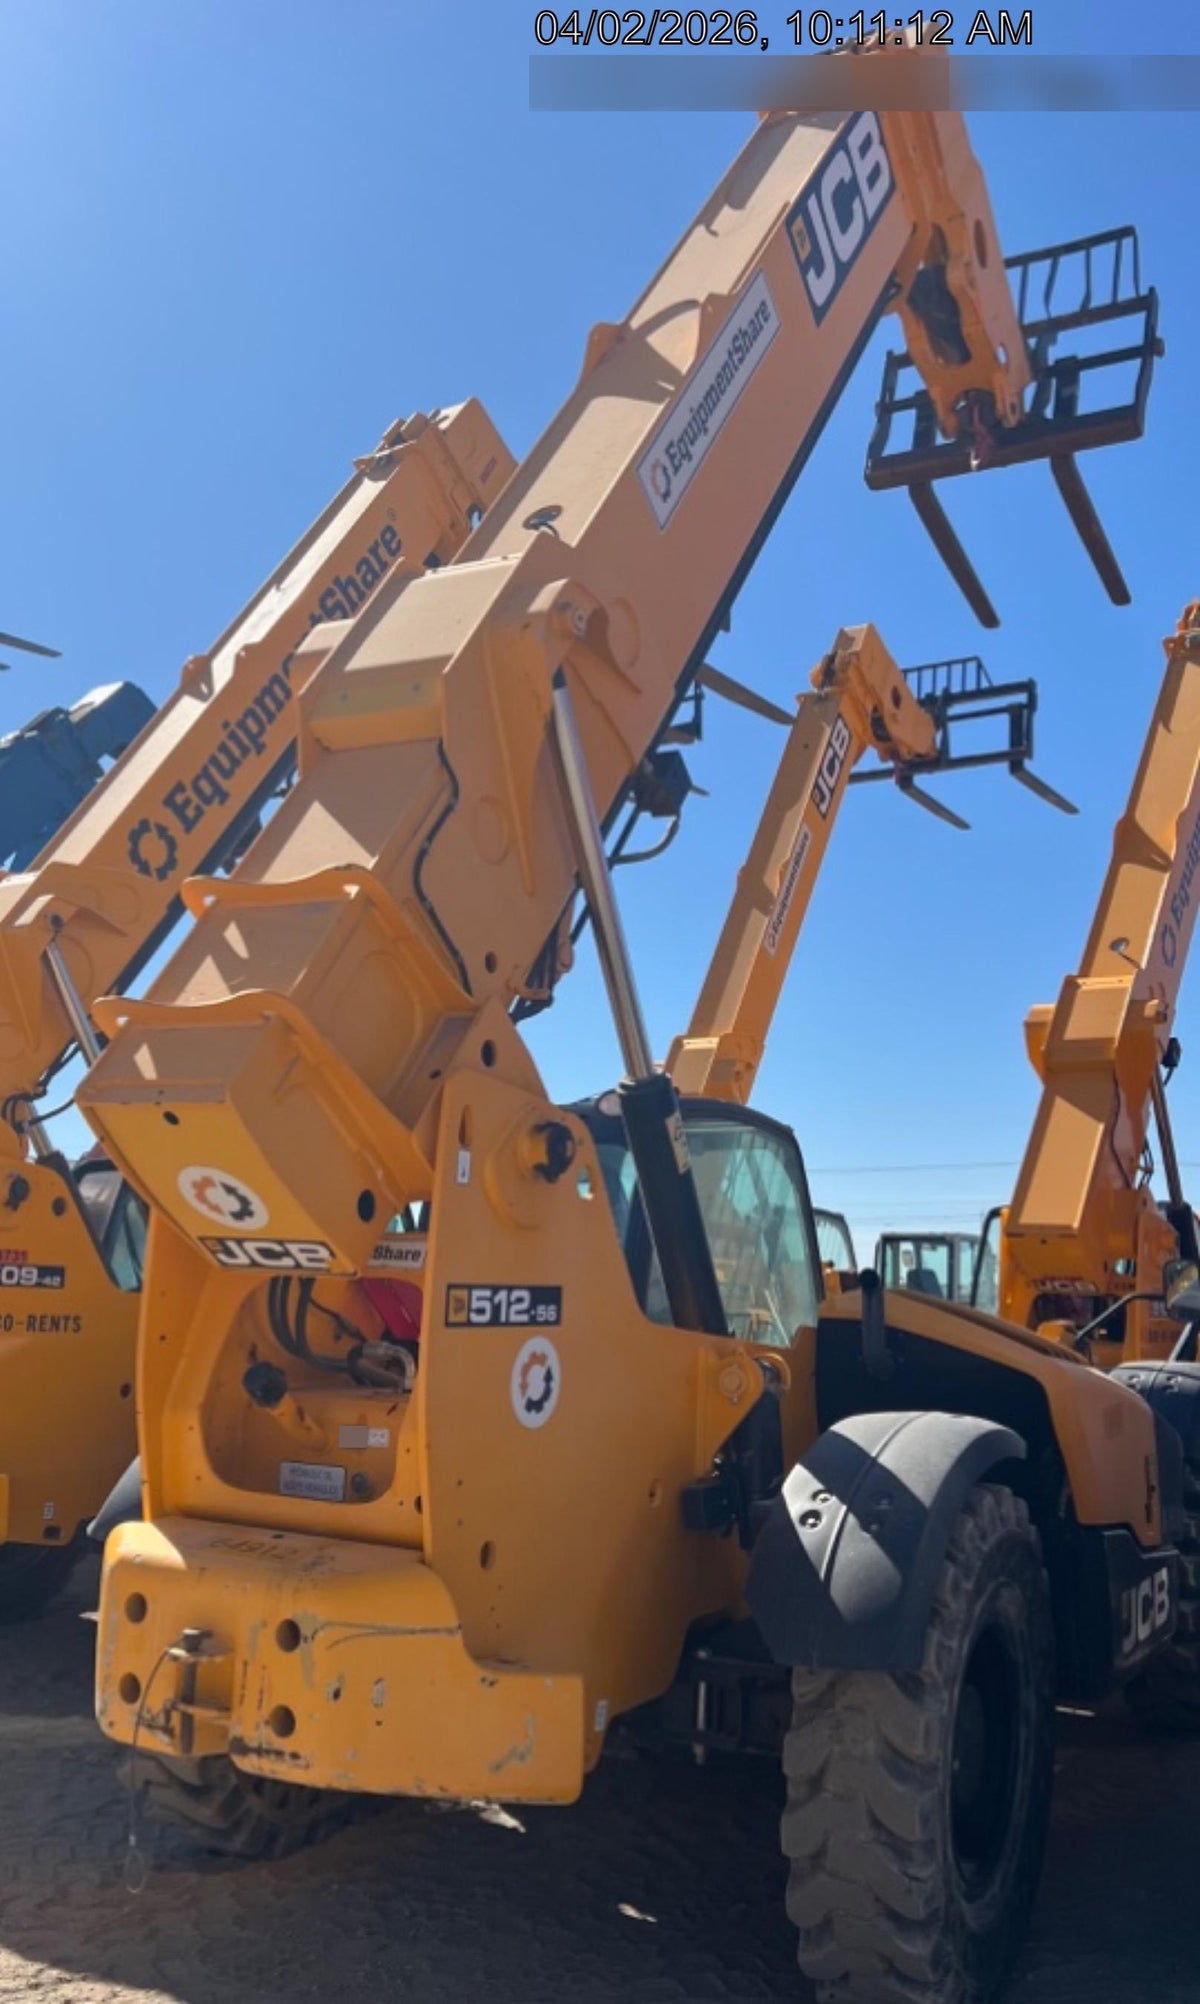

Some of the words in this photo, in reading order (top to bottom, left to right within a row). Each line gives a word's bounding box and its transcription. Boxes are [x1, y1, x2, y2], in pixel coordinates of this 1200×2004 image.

[806, 111, 892, 308] JCB
[664, 300, 771, 477] EquipmentShare
[162, 525, 402, 835] EquipmShare
[818, 718, 850, 814] JCB
[215, 1239, 334, 1269] JCB
[373, 1245, 411, 1262] Share
[1121, 1566, 1169, 1653] JCB
